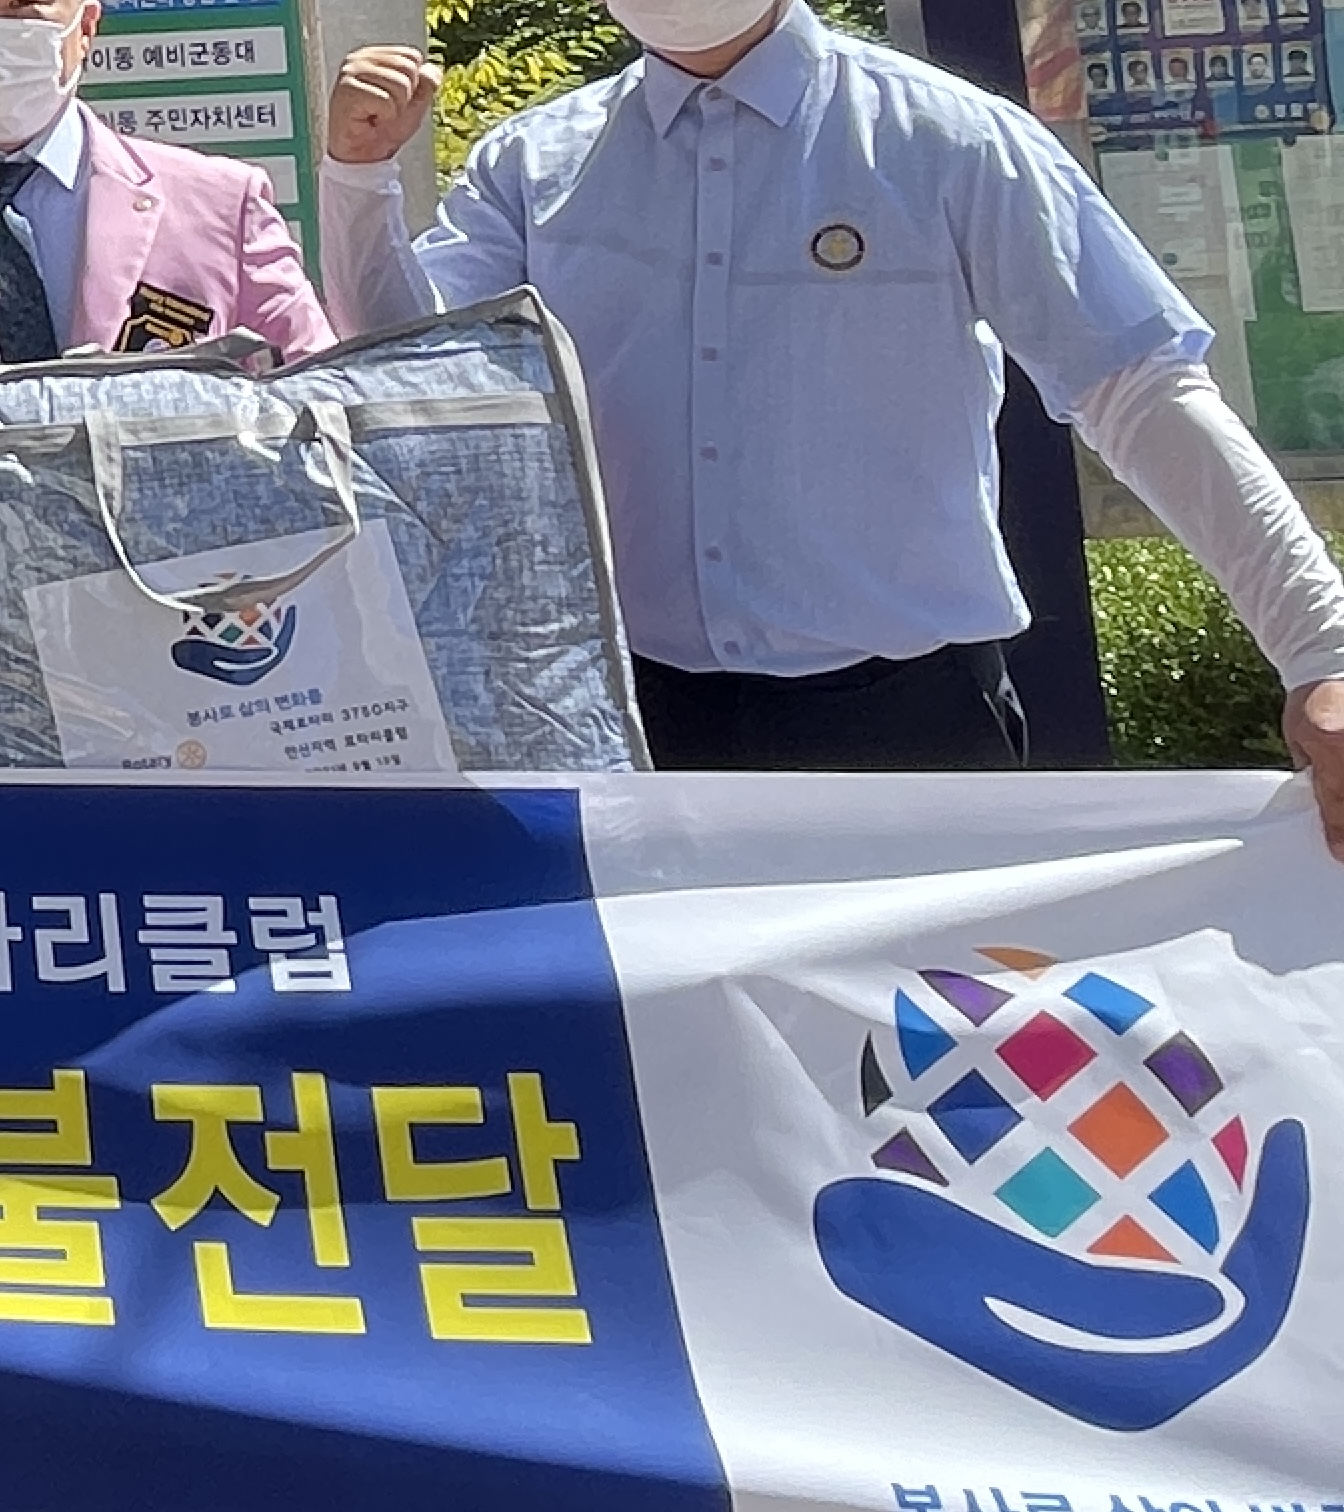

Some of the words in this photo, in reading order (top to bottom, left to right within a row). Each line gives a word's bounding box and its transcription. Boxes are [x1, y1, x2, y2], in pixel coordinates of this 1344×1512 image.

[81, 46, 134, 72] 이동
[143, 39, 256, 70] 예비군동대
[145, 103, 276, 134] 주민자치센터
